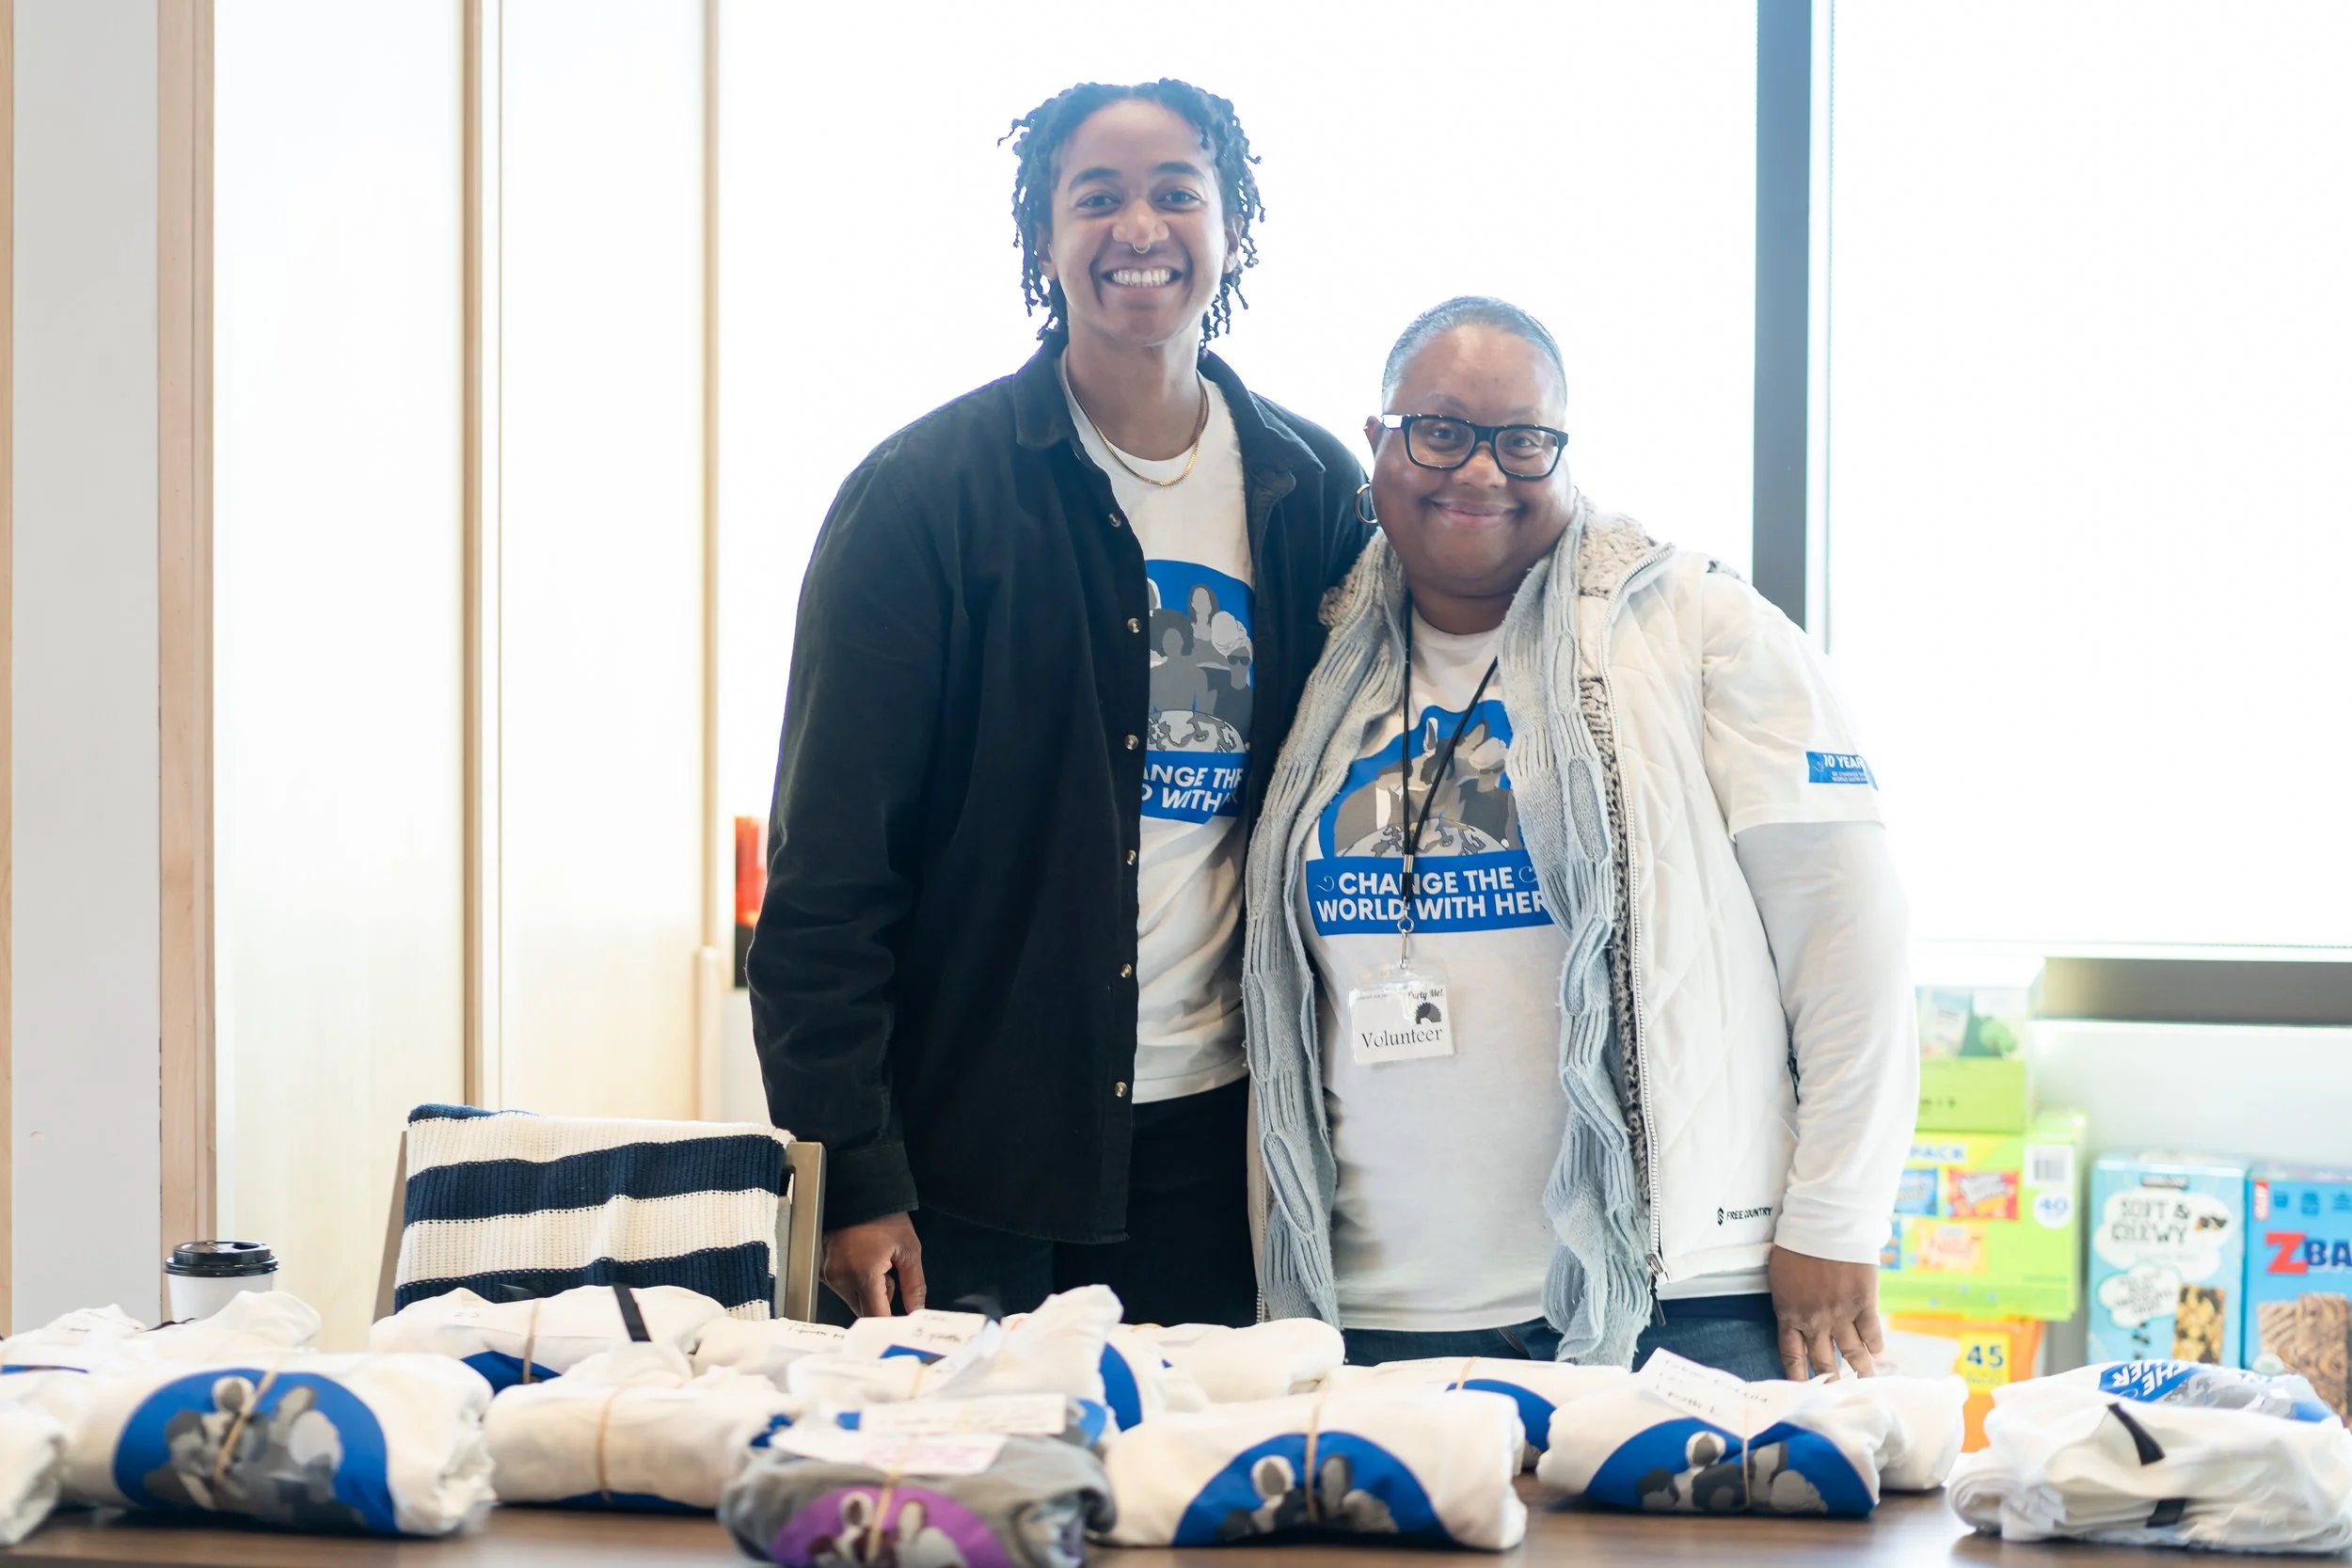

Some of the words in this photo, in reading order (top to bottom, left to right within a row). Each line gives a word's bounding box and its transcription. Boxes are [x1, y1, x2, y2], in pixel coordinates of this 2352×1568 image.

[1823, 753, 1836, 768] 10
[1161, 787, 1223, 813] WITH
[1463, 866, 1516, 891] THE
[1315, 897, 1406, 923] WORLD
[1414, 895, 1486, 921] WITH
[1360, 1028, 1443, 1049] Volunteer
[1725, 1211, 1743, 1221] FREE
[1965, 1344, 2004, 1368] 45
